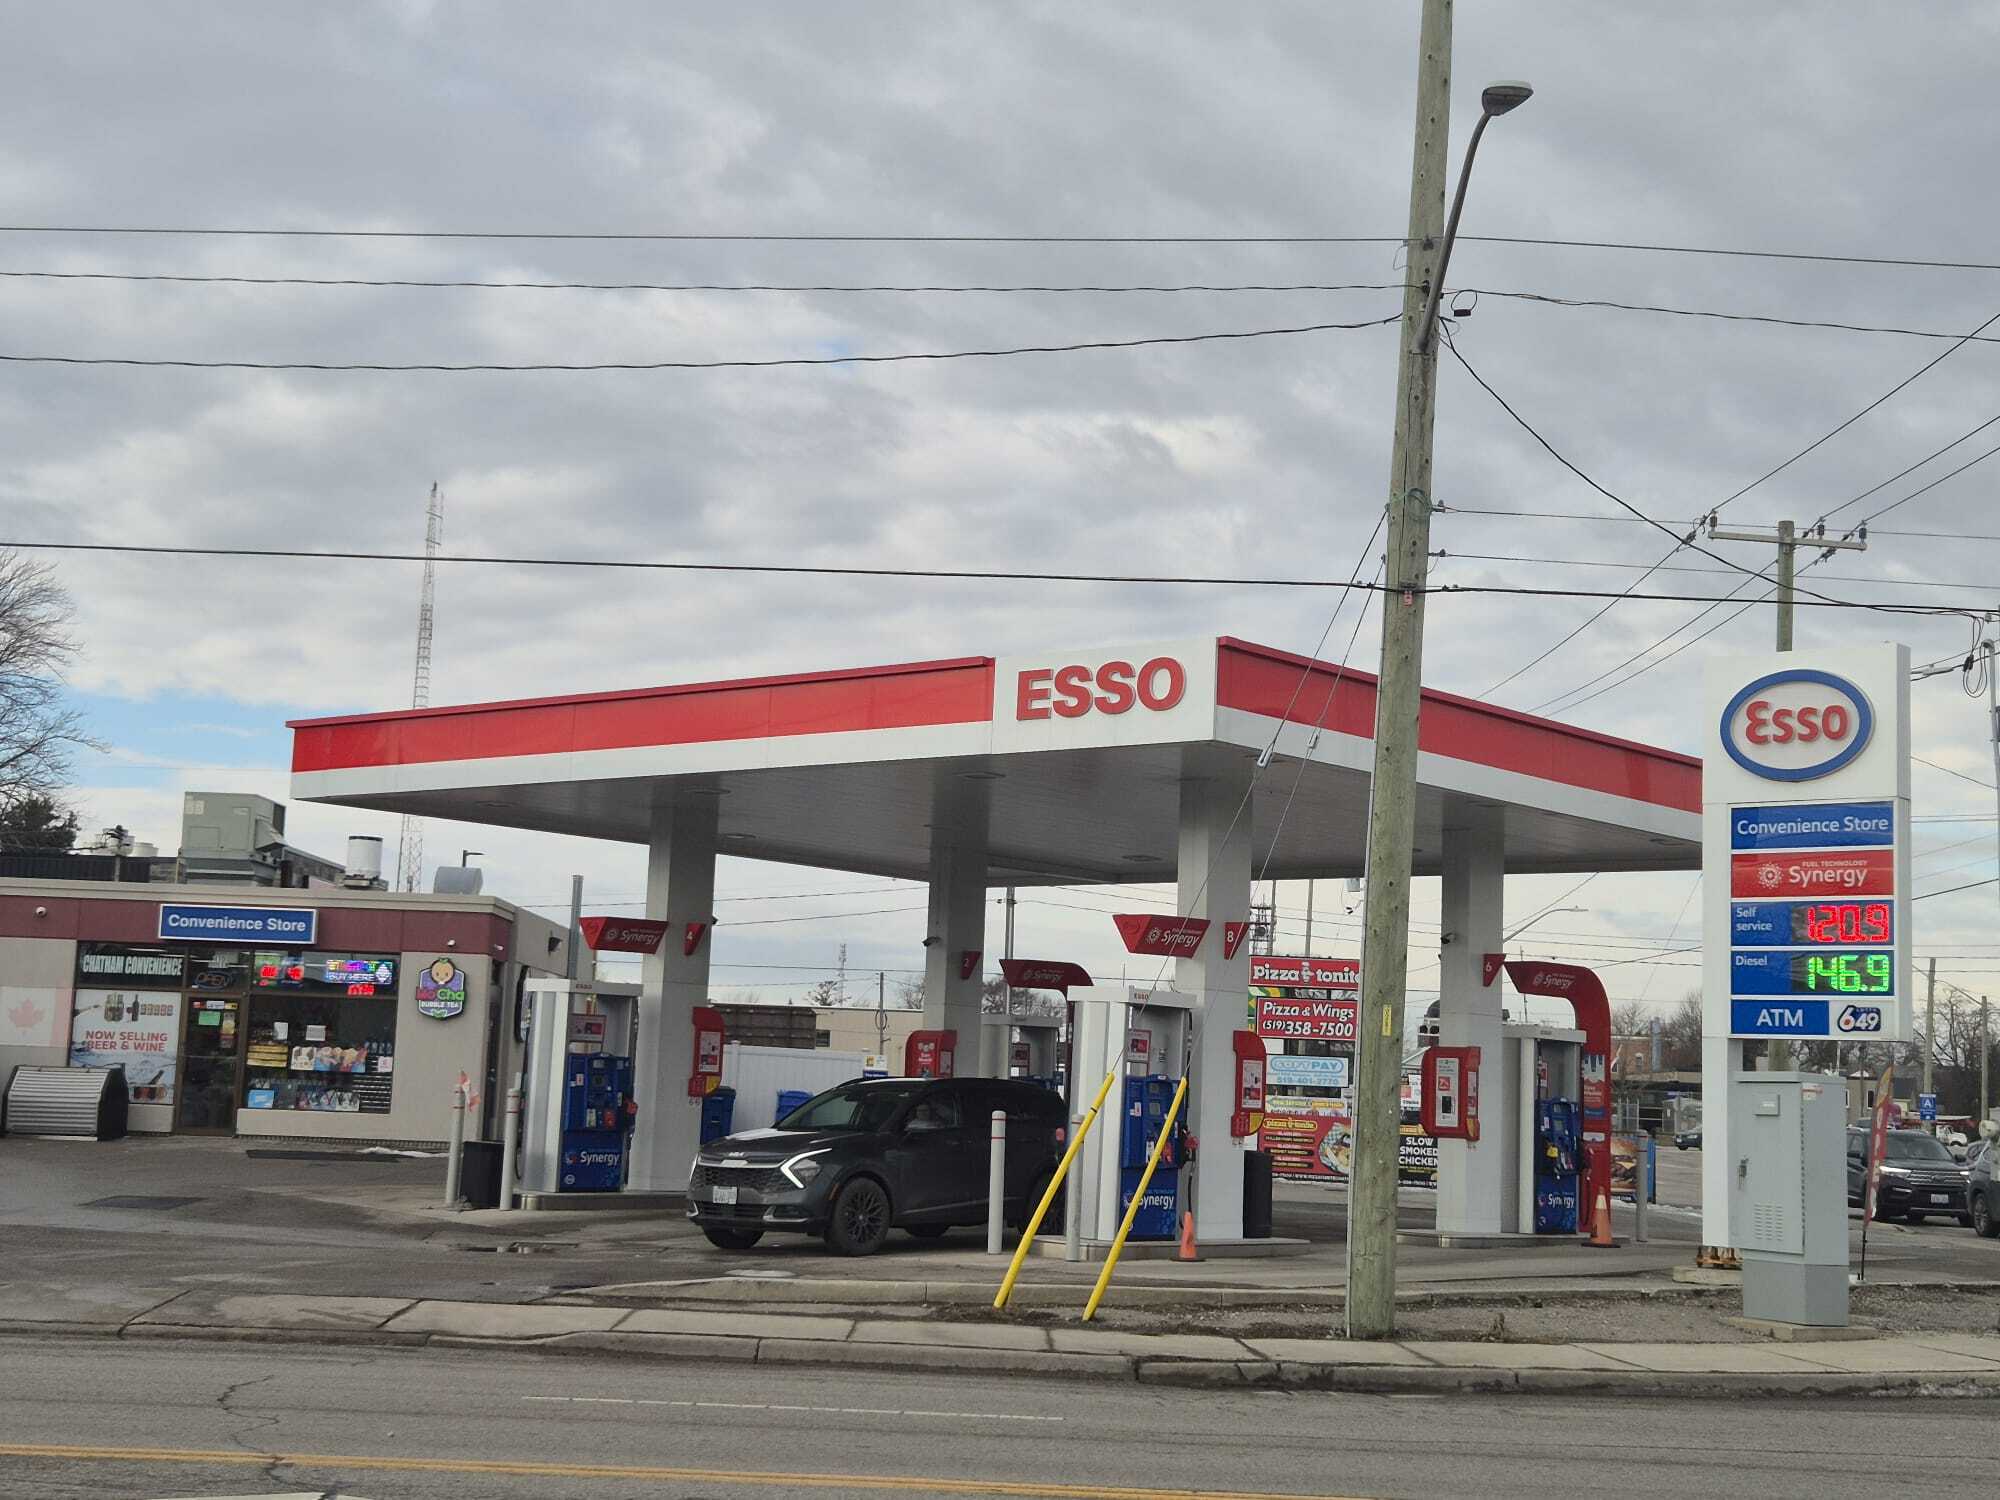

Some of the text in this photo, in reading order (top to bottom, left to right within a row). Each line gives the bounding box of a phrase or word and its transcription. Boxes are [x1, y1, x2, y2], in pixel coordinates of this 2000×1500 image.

[1017, 656, 1187, 721] ESSO
[1745, 700, 1849, 746] ESSO
[1737, 816, 1889, 835] Convenience Store
[1789, 866, 1868, 888] Synergy
[1736, 907, 1757, 918] Self
[168, 914, 306, 932] Convenience Store
[1736, 920, 1773, 932] service
[621, 929, 660, 945] Synergy
[1161, 929, 1200, 948] Synergy
[1227, 931, 1234, 943] 8
[82, 954, 183, 976] CHATHAM CONVENIENCE
[1485, 962, 1493, 972] 6
[1735, 955, 1767, 966] Diesel
[1252, 962, 1300, 981] Pizza
[1807, 954, 1889, 992] 146.9
[1263, 1001, 1355, 1021] Pizza & Wings
[1756, 1008, 1804, 1028] ATM
[86, 1030, 169, 1042] NOW SELLING
[1262, 1019, 1354, 1037] (519)358-7500
[86, 1040, 166, 1052] BEER & WINE
[1406, 1136, 1434, 1146] SLOW
[580, 1151, 620, 1167] Synergy
[1399, 1146, 1438, 1156] SMOKED
